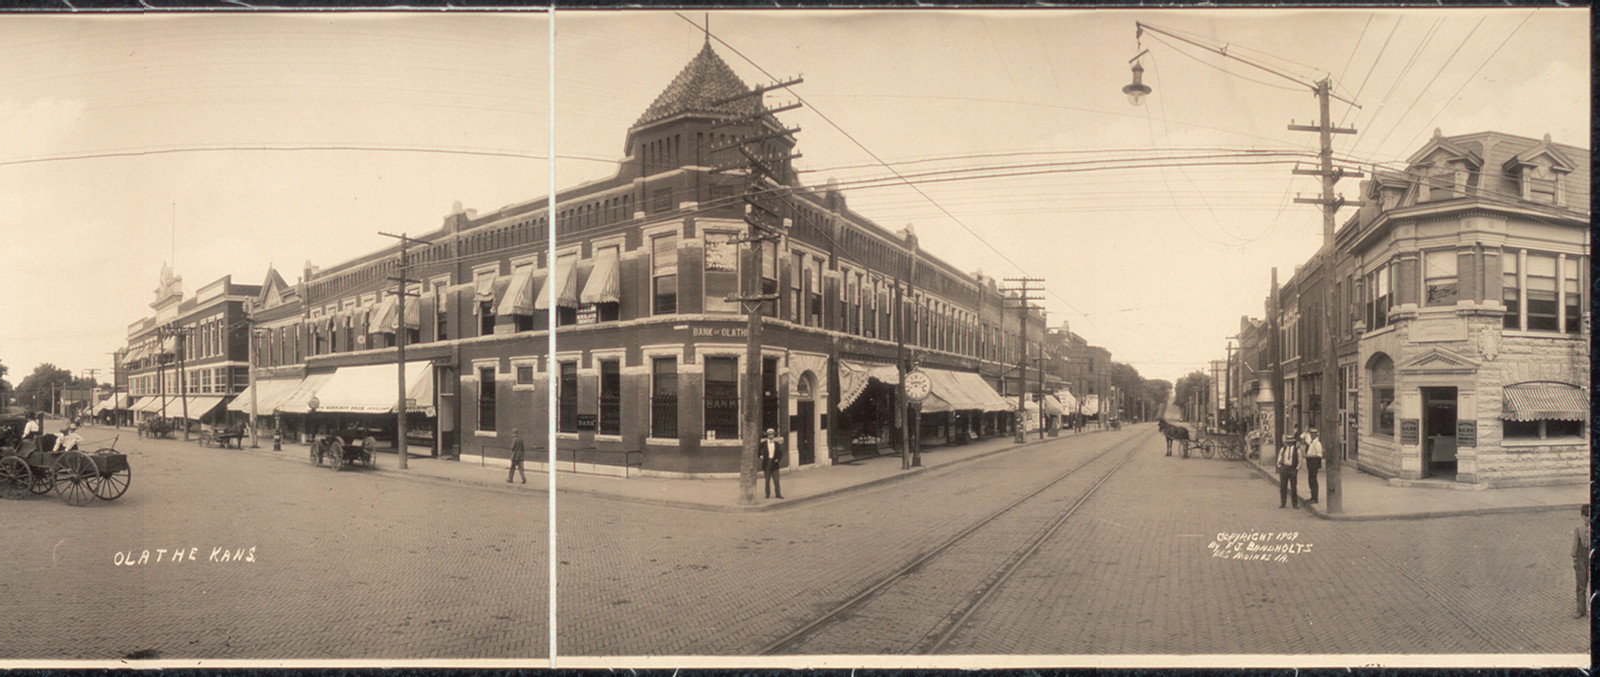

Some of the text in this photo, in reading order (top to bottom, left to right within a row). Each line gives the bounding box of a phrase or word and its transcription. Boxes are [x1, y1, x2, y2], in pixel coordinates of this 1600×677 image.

[693, 328, 713, 336] BANK
[721, 328, 748, 337] OLATH
[706, 400, 737, 408] BANK
